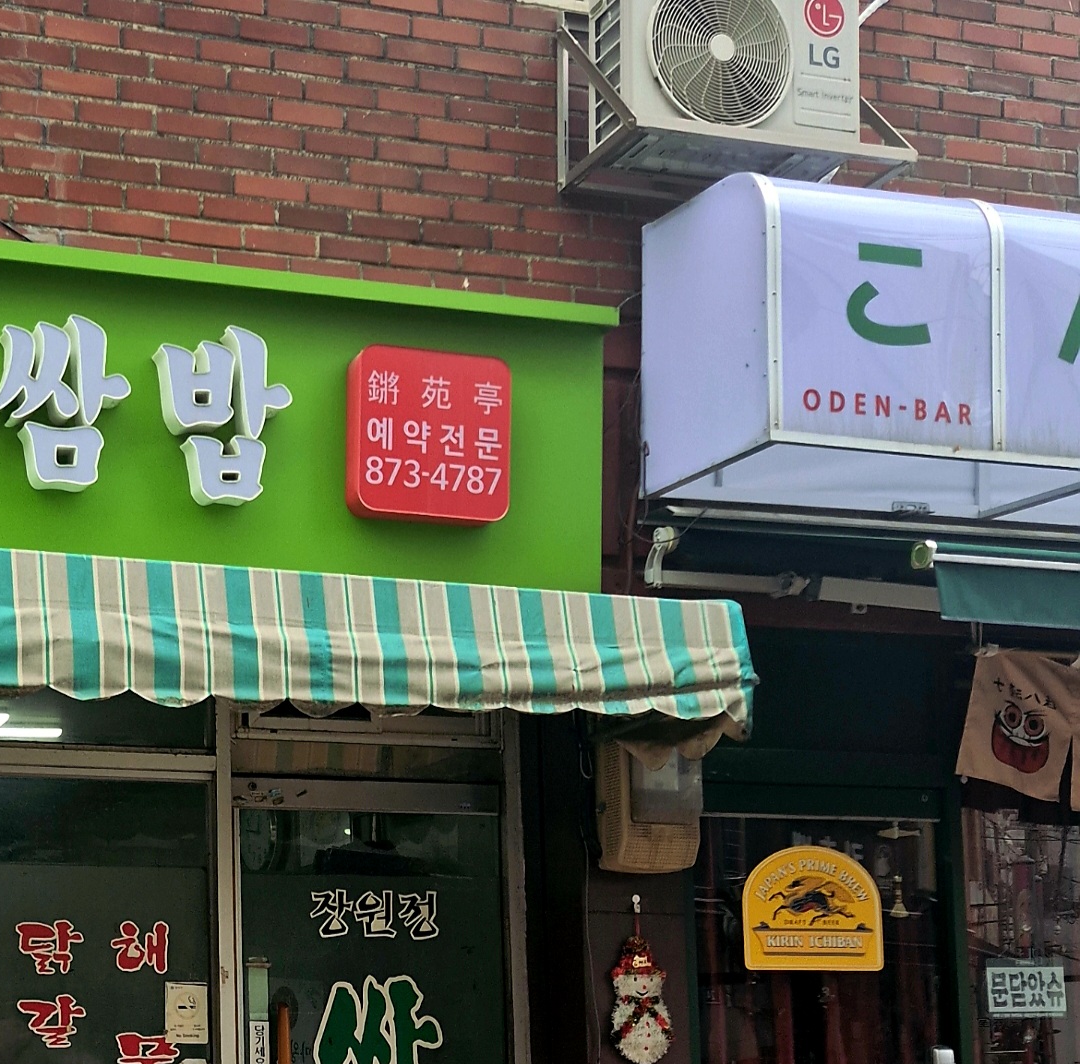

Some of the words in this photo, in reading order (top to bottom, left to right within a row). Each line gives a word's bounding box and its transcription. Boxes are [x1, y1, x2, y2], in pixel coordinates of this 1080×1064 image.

[809, 43, 840, 69] LG
[802, 388, 972, 426] ODEN-BAR
[367, 417, 502, 461] 예약전문
[365, 456, 502, 496] 873-4787
[755, 862, 797, 901] JAPAN'S
[799, 859, 837, 877] PRIME
[838, 870, 870, 902] BREW
[310, 889, 439, 940] 장원정
[767, 935, 804, 948] KIRIN
[809, 935, 863, 948] ICHIBAN
